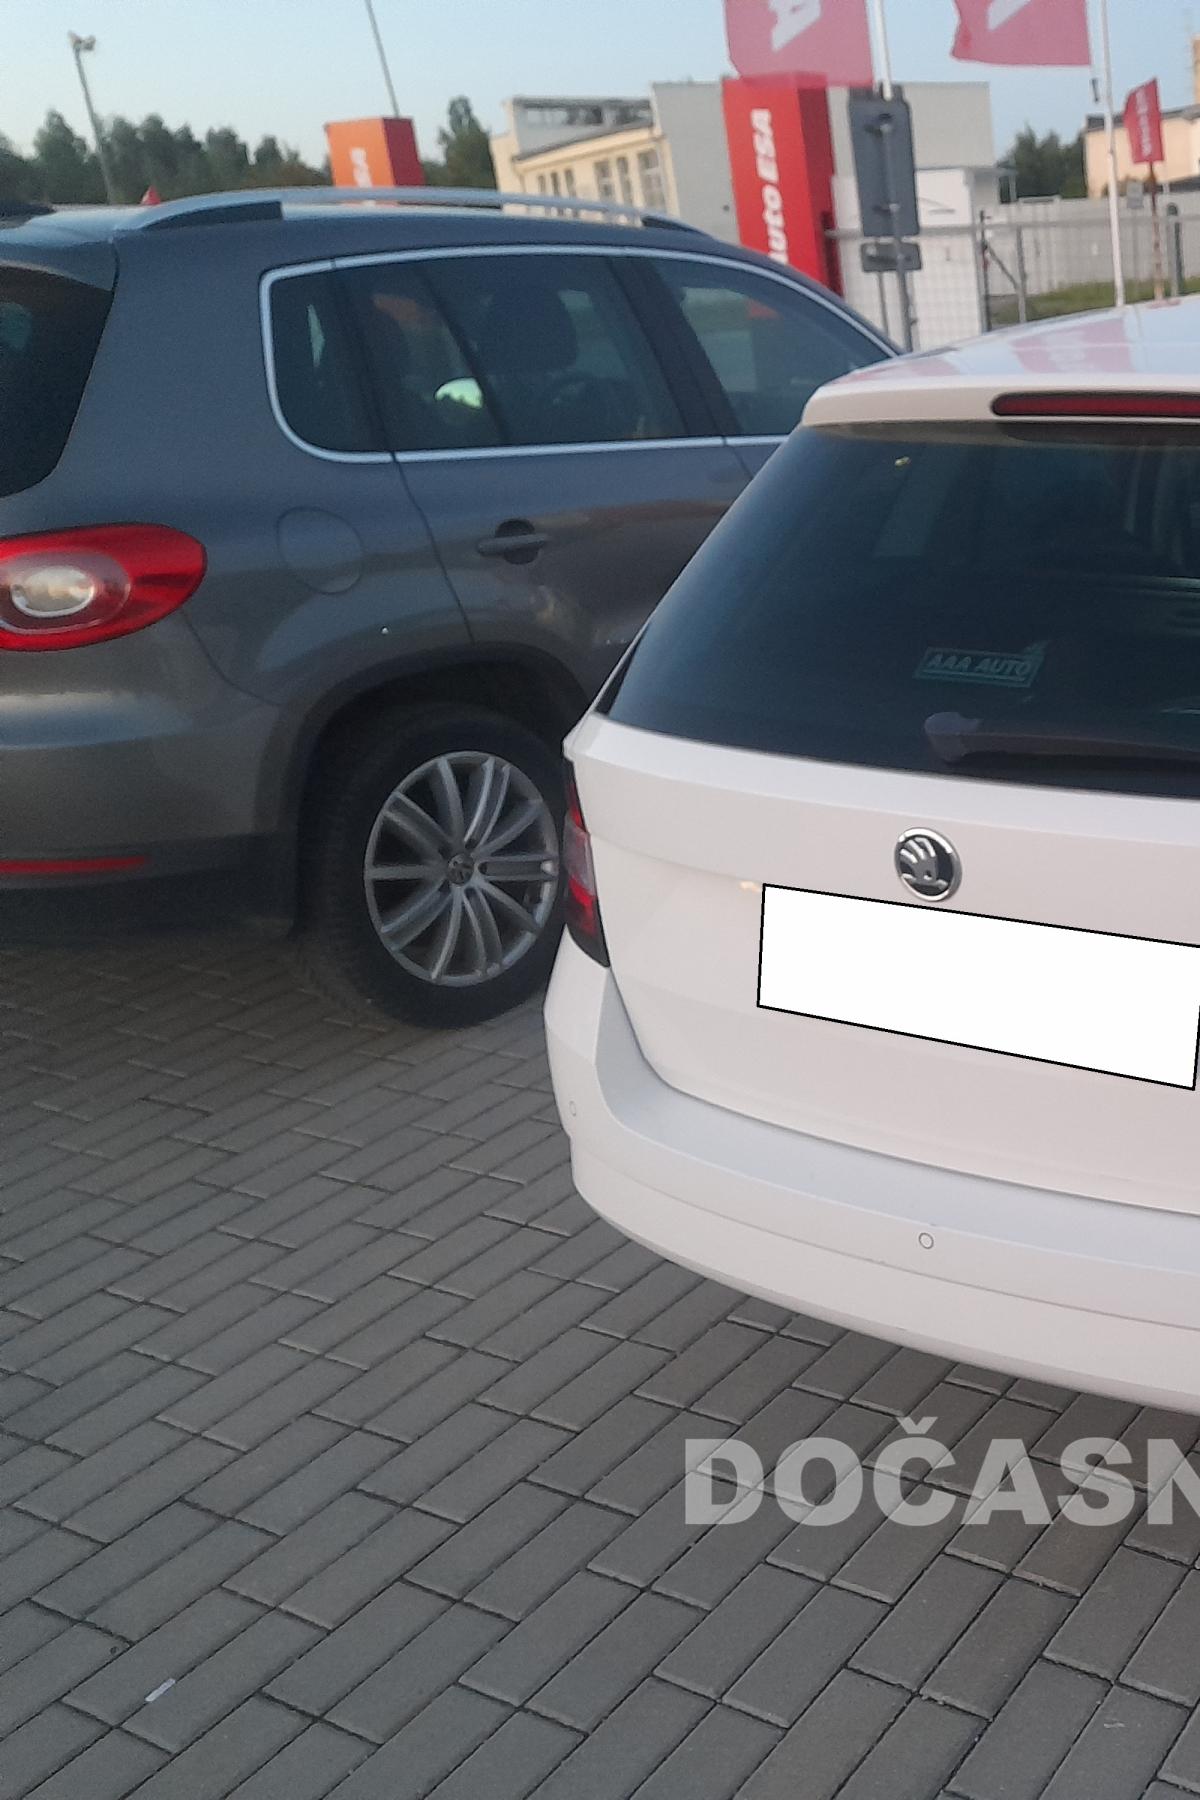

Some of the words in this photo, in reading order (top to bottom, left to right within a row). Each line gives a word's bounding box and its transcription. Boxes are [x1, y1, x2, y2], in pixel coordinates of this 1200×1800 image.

[751, 108, 779, 184] ESA
[927, 653, 972, 672] AAA
[975, 657, 1032, 677] AUTO
